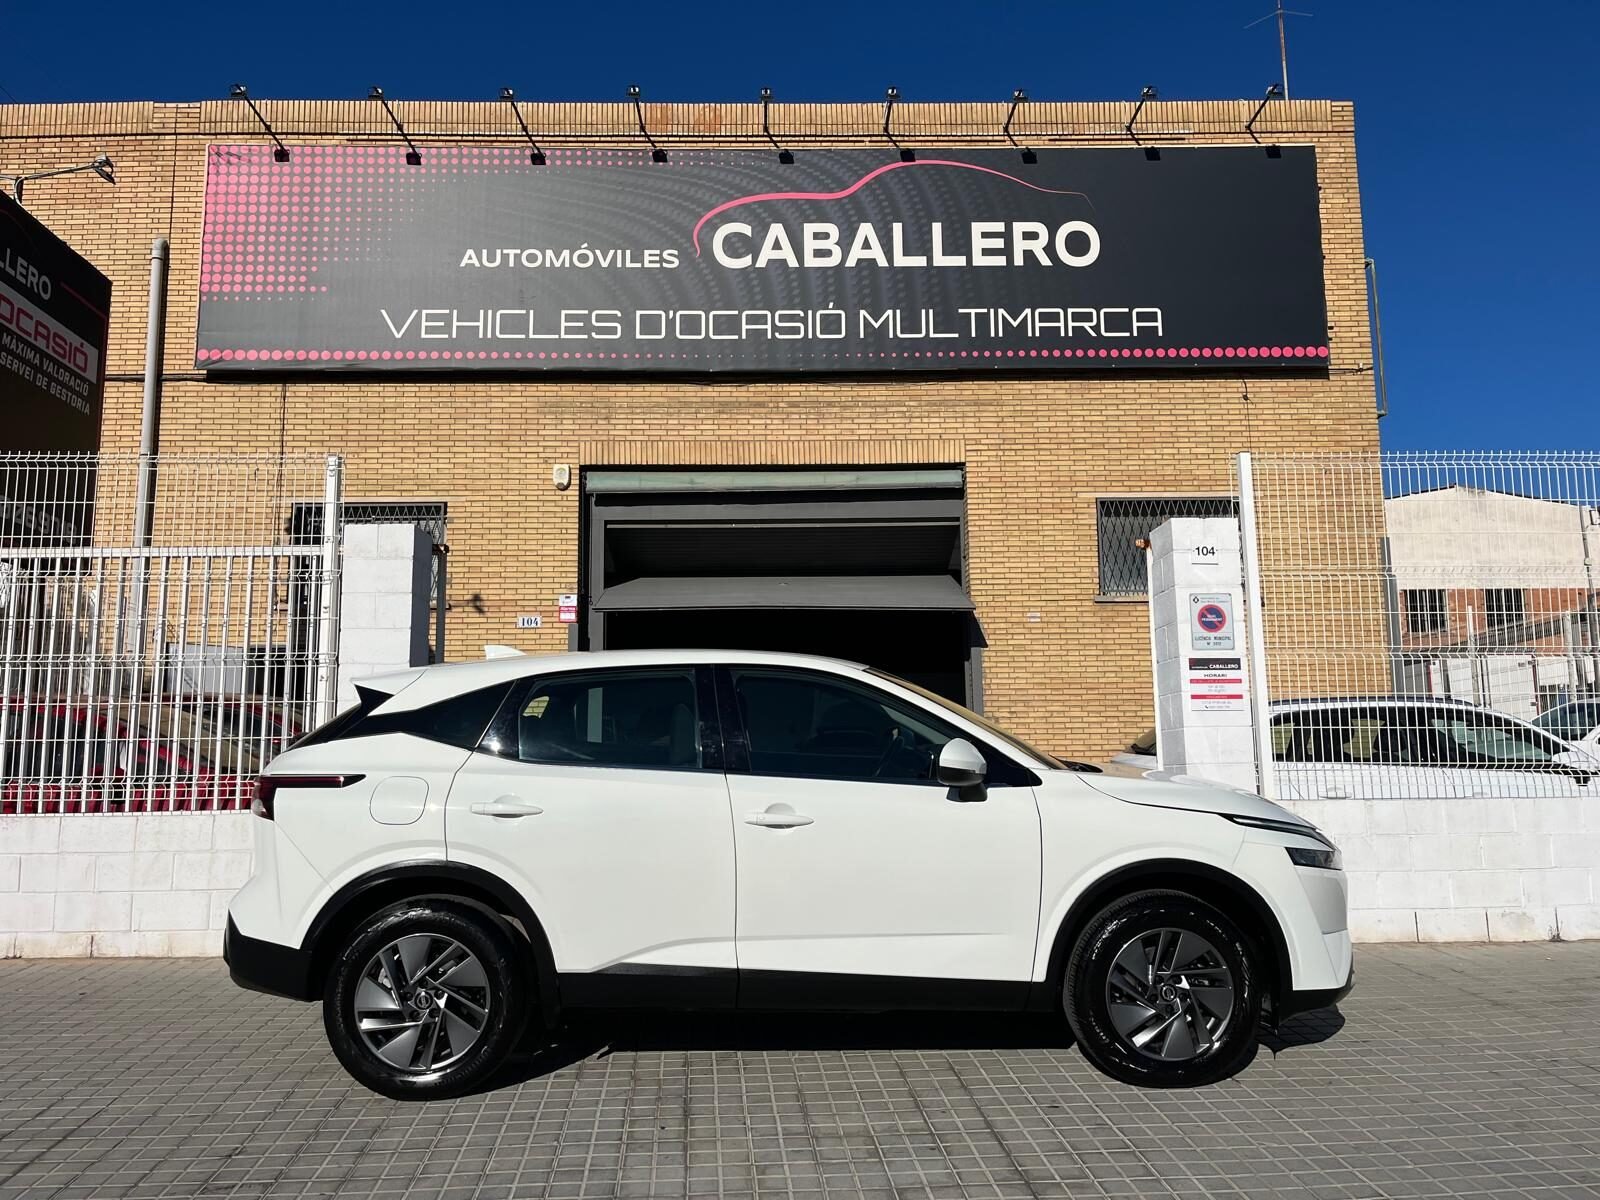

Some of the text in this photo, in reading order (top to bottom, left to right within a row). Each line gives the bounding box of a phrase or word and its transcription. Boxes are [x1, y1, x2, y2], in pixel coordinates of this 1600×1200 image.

[460, 221, 1101, 270] AUTOMÓVILES CABALLERO
[0, 248, 51, 300] LERO
[380, 302, 1163, 340] VEHICLES D'OCASIÓ MULTIMARCA
[0, 351, 90, 416] SERVEI DE GESTORIA
[43, 358, 89, 396] VALORACIÓ
[1195, 546, 1216, 556] 104
[522, 617, 538, 627] 104
